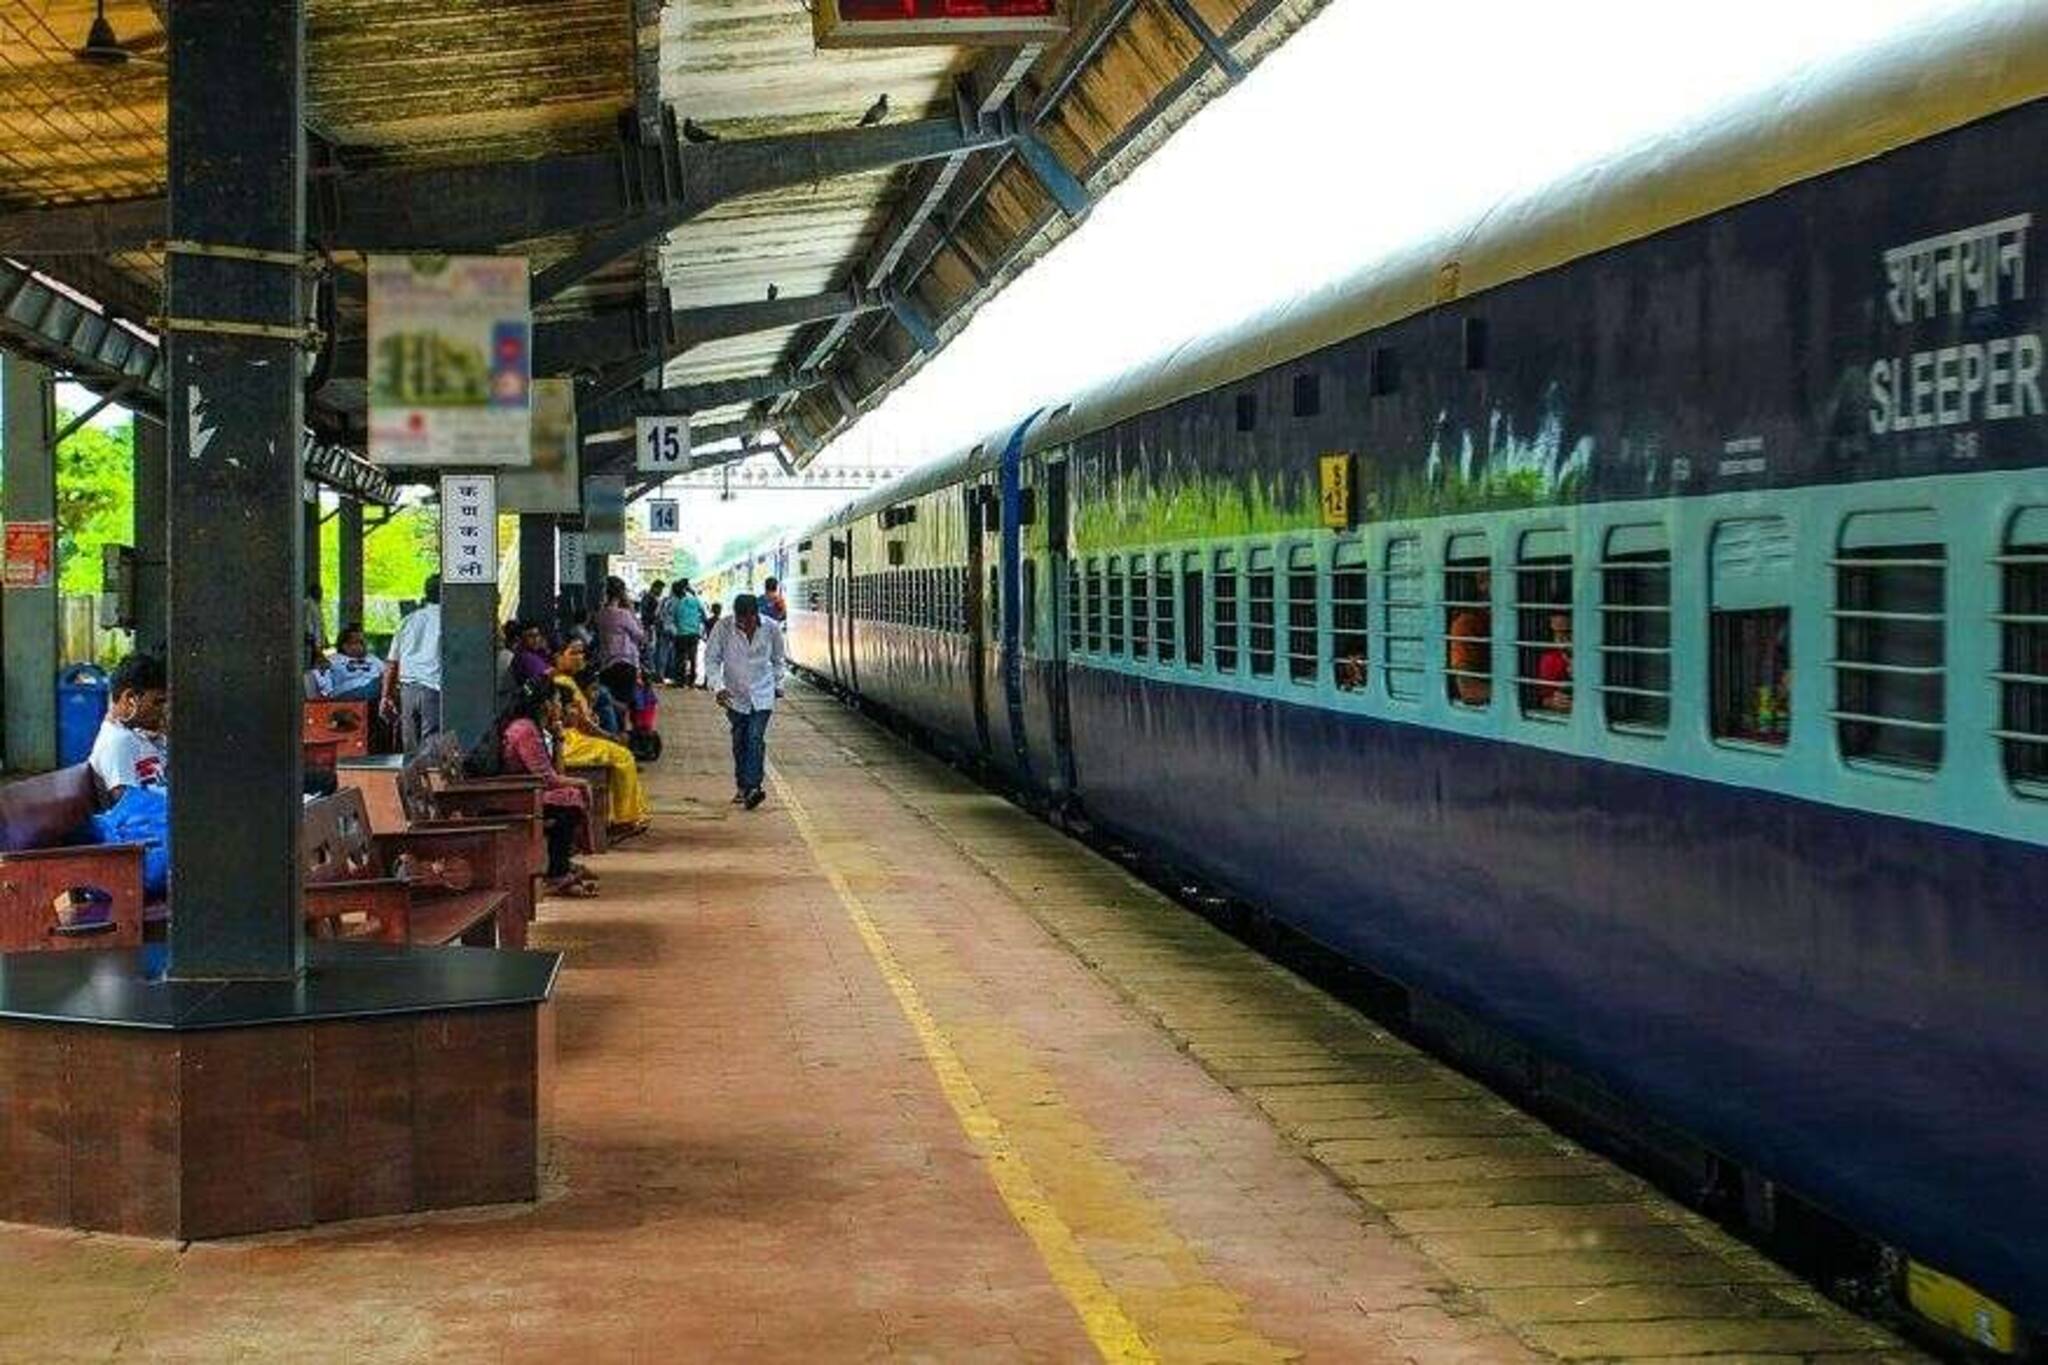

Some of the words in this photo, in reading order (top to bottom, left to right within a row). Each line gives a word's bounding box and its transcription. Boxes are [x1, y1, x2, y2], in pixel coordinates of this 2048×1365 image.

[1883, 213, 2033, 322] शयनयान
[1868, 334, 2044, 434] SLEEPER
[648, 425, 680, 462] 15
[656, 507, 674, 528] 14
